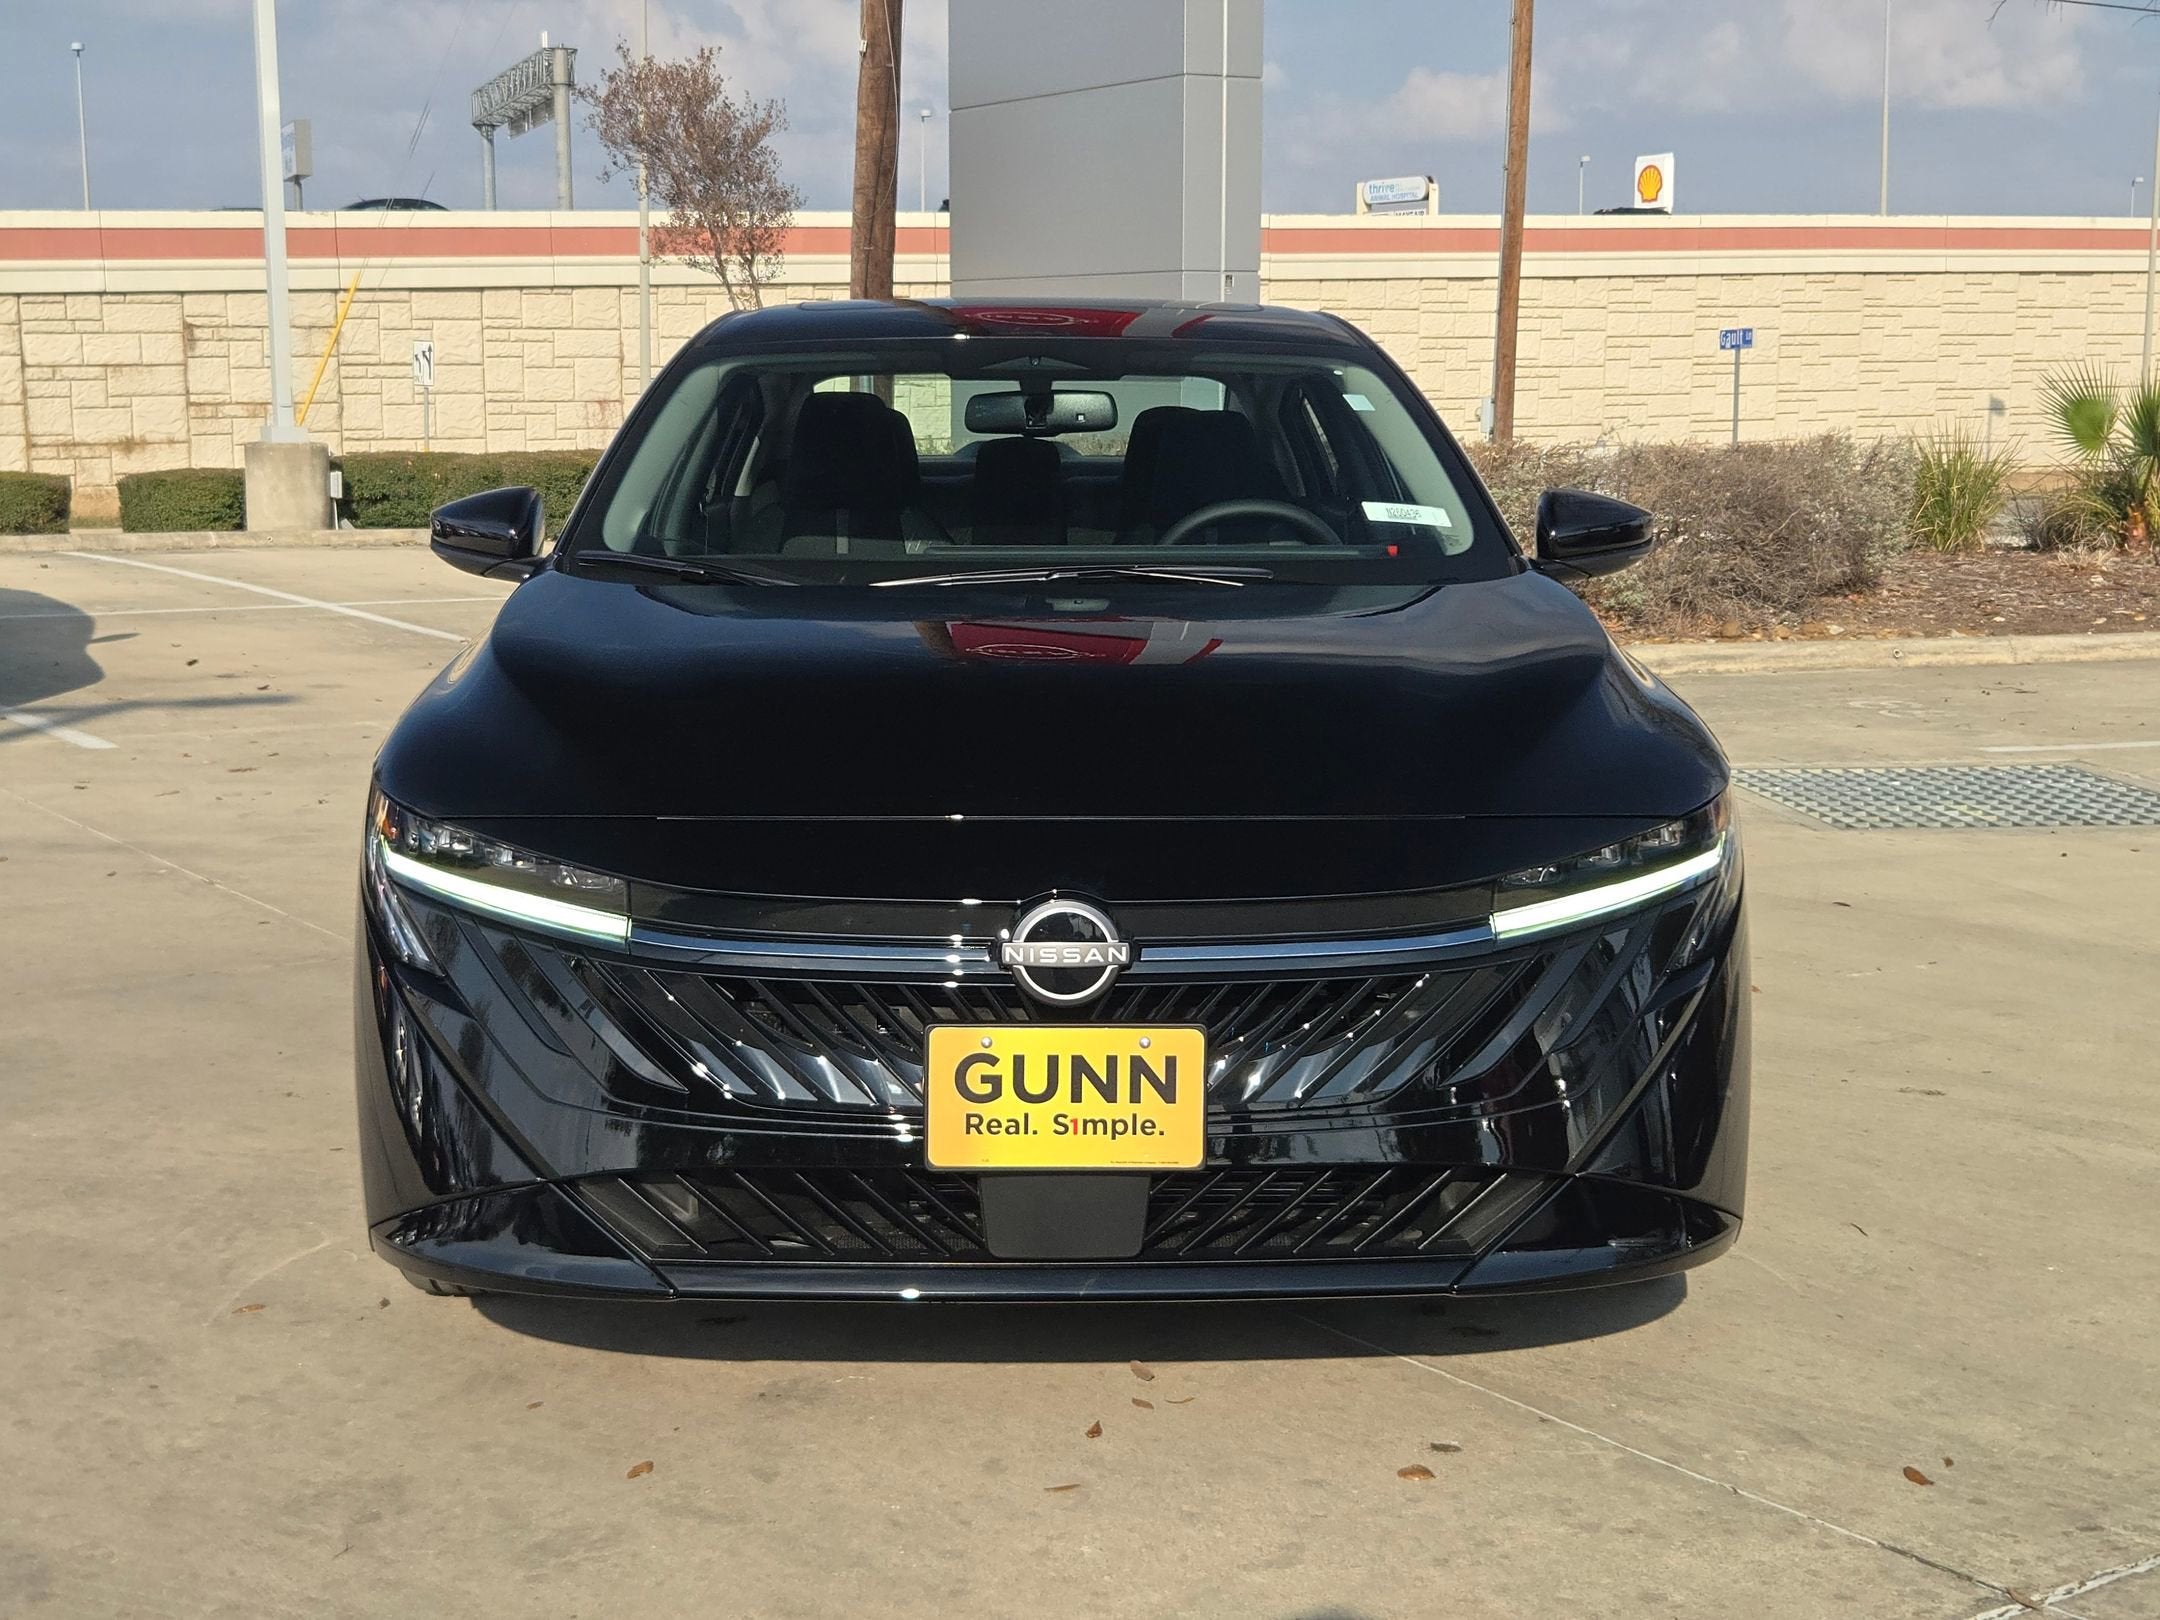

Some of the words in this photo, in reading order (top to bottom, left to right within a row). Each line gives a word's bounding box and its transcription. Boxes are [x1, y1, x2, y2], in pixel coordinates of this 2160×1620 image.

[1369, 182, 1395, 194] thrive
[1720, 330, 1743, 347] Gault
[1005, 946, 1127, 963] NISSAN
[954, 1052, 1177, 1104] GUNN
[965, 1112, 1038, 1136] Real.
